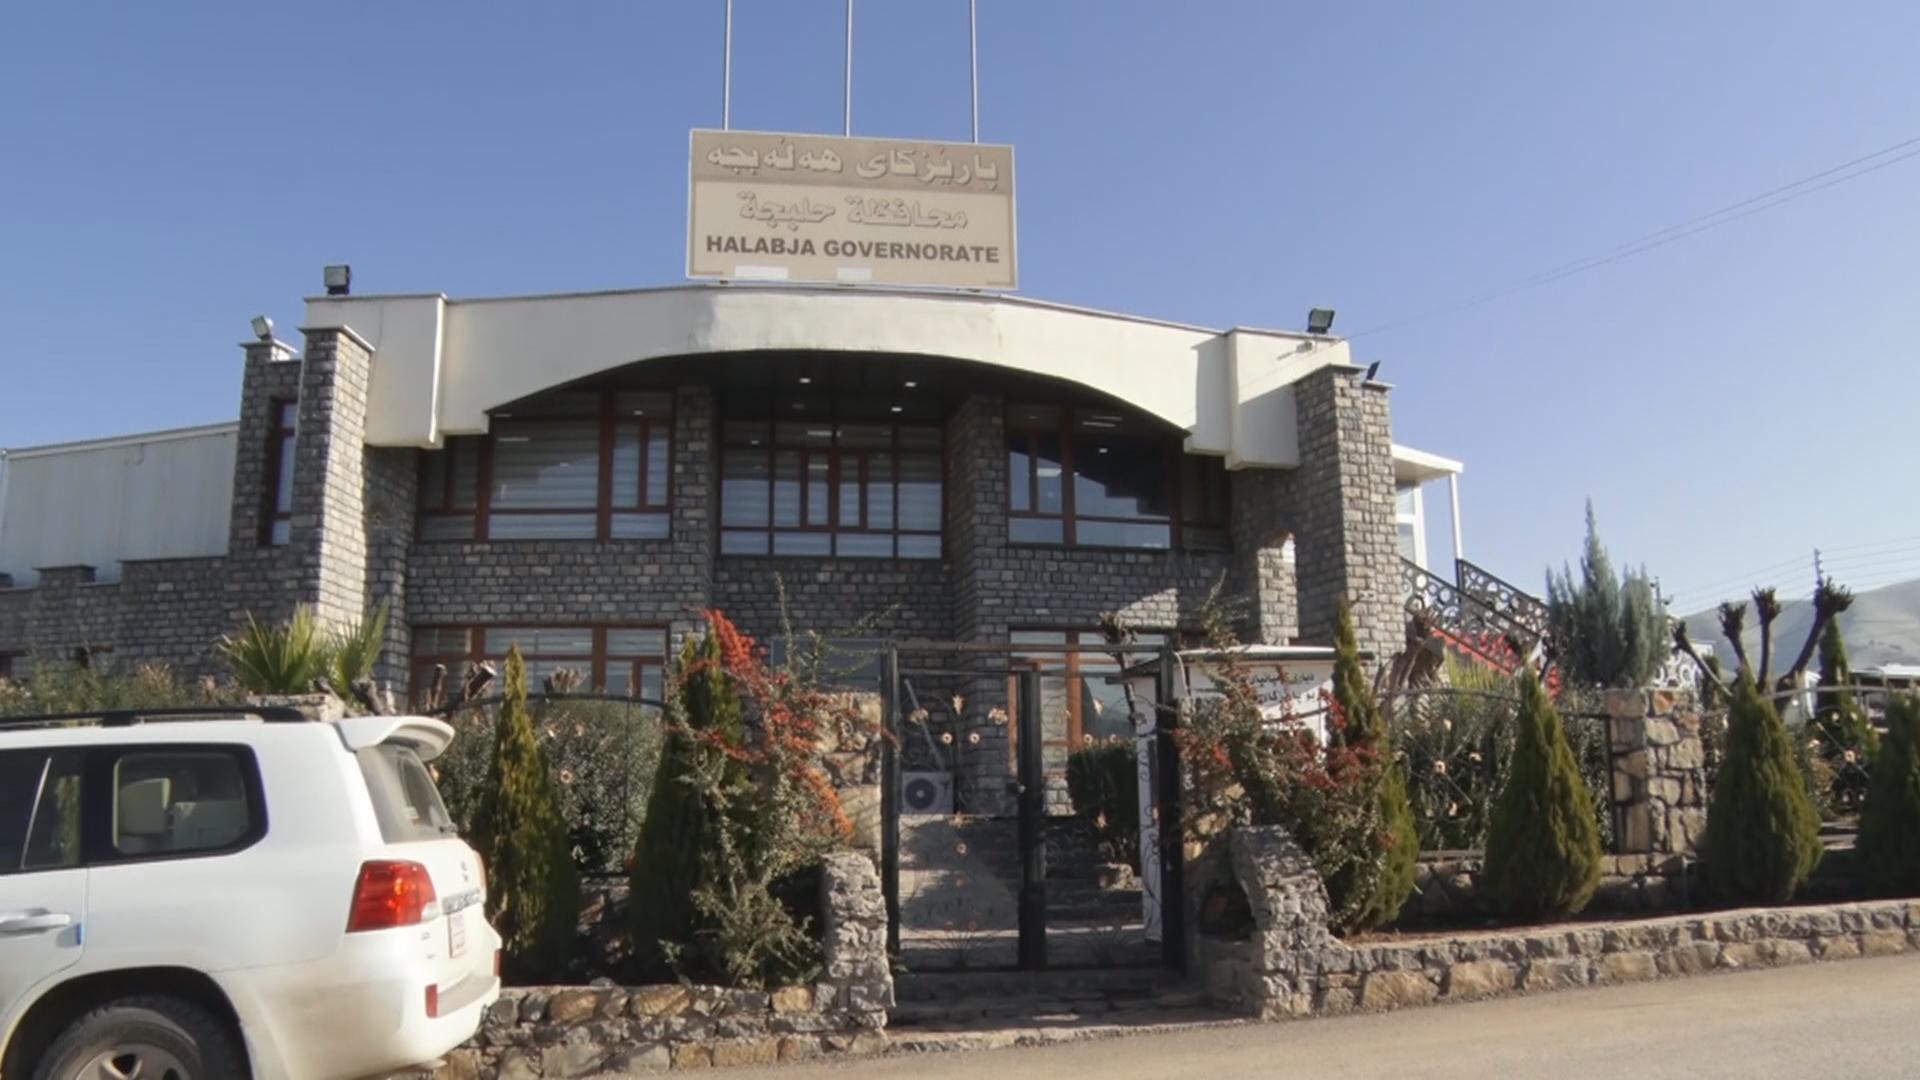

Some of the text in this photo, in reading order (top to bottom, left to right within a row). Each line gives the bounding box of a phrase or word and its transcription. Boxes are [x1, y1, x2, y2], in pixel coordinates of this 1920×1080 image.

[737, 190, 968, 232] محافظة حلبجة
[706, 235, 1000, 263] HALABJA GOVERNORATE
